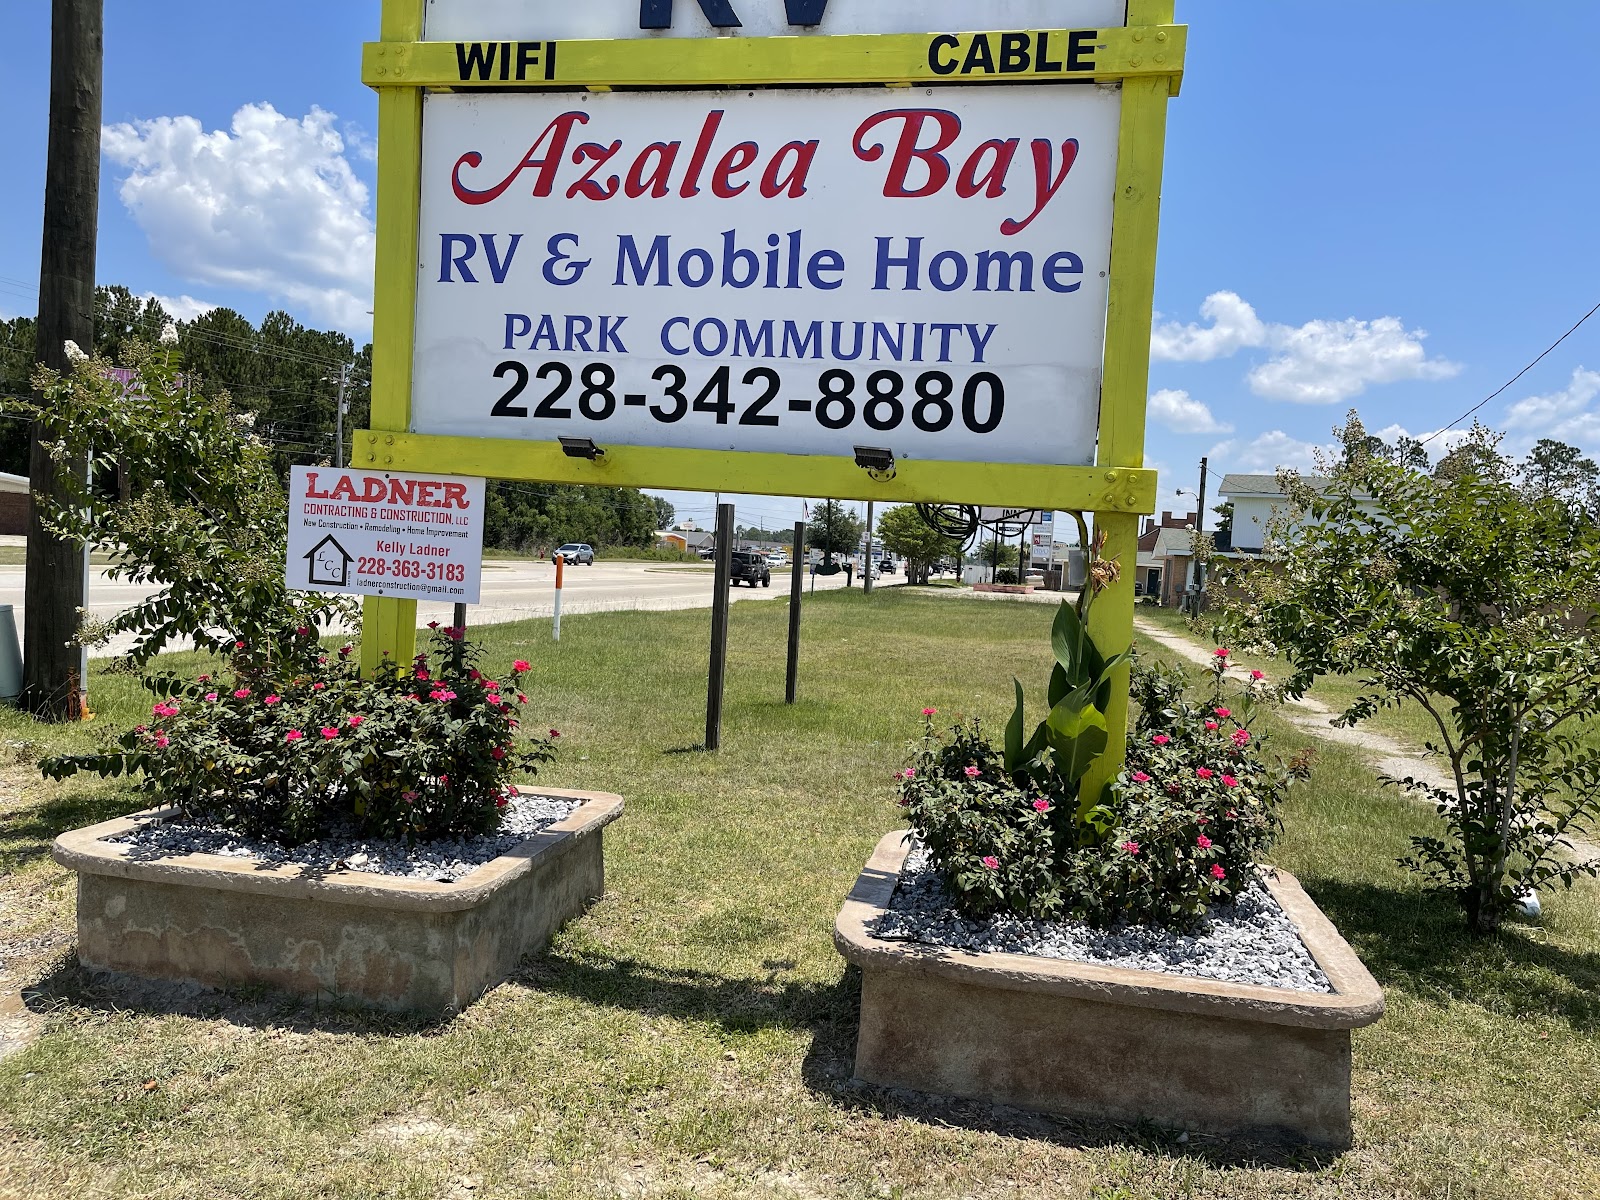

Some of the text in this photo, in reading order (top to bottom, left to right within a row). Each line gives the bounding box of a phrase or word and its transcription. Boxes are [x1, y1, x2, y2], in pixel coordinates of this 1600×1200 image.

[456, 42, 556, 80] WIFI
[928, 31, 1097, 75] CABLE
[451, 108, 1080, 235] Azalea Bay
[437, 229, 1084, 293] RV & Mobile Home
[502, 313, 999, 363] PARK COMMUNITY
[490, 360, 1005, 434] 228-342-8880
[305, 472, 470, 510] LADNER
[303, 503, 368, 519] CONTRACTING
[371, 508, 378, 518] &
[455, 516, 469, 526] LLC
[303, 518, 469, 539] New Construction Remodeling Home Improvement
[376, 540, 451, 557] Kelly Ladner
[356, 578, 465, 595] ladnerconstruction@gmail.com
[357, 556, 465, 582] 228-363-3183
